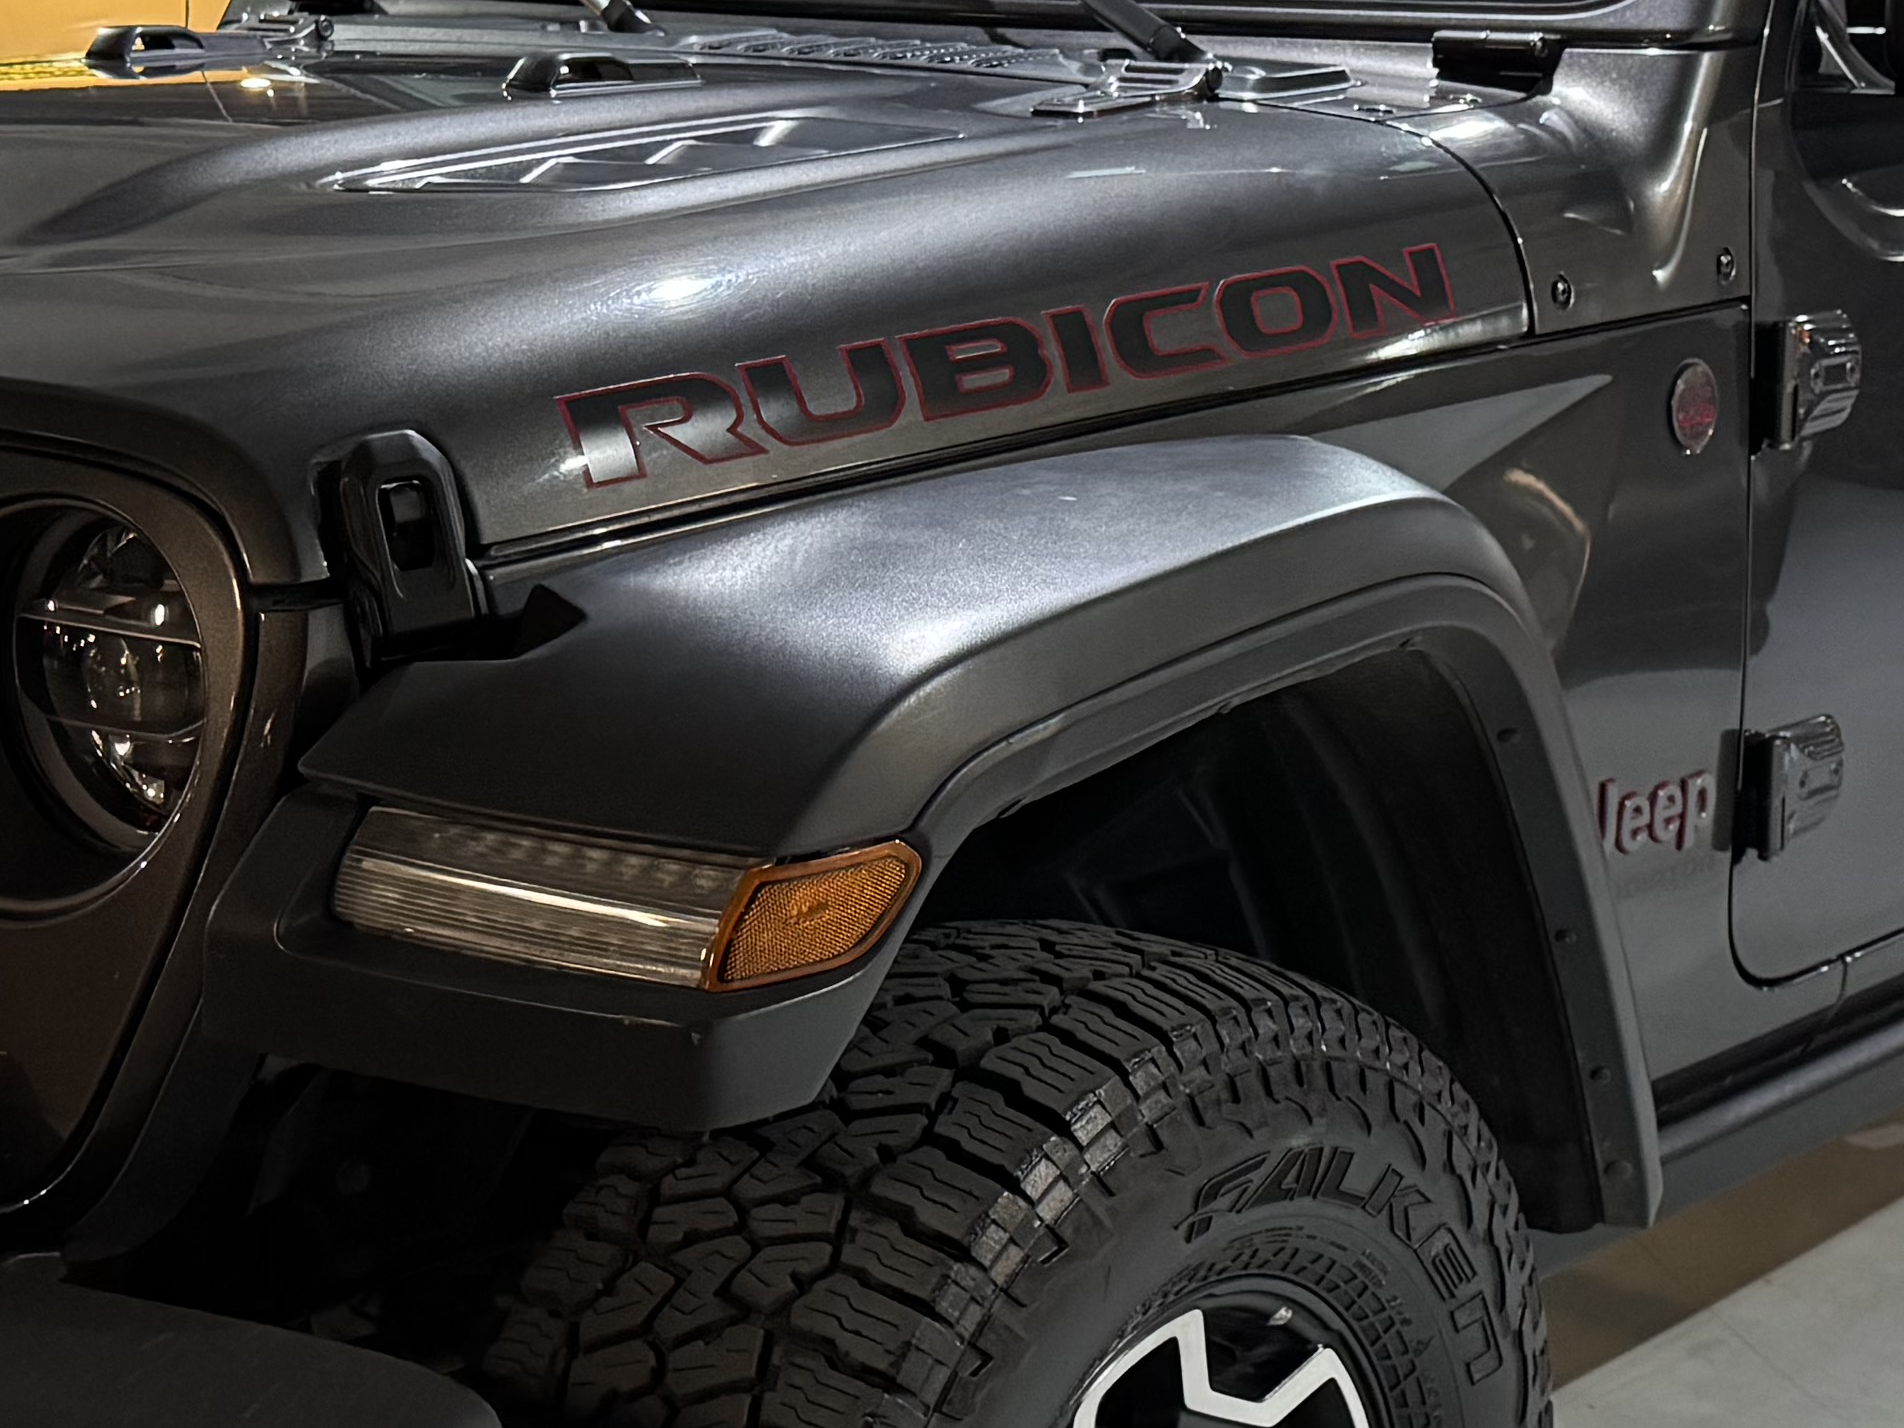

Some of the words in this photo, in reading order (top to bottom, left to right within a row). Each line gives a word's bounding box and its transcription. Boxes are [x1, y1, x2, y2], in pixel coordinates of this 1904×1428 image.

[553, 243, 1455, 489] RUBICON
[1597, 769, 1716, 860] Jeep
[1173, 1142, 1503, 1386] FALKEN
